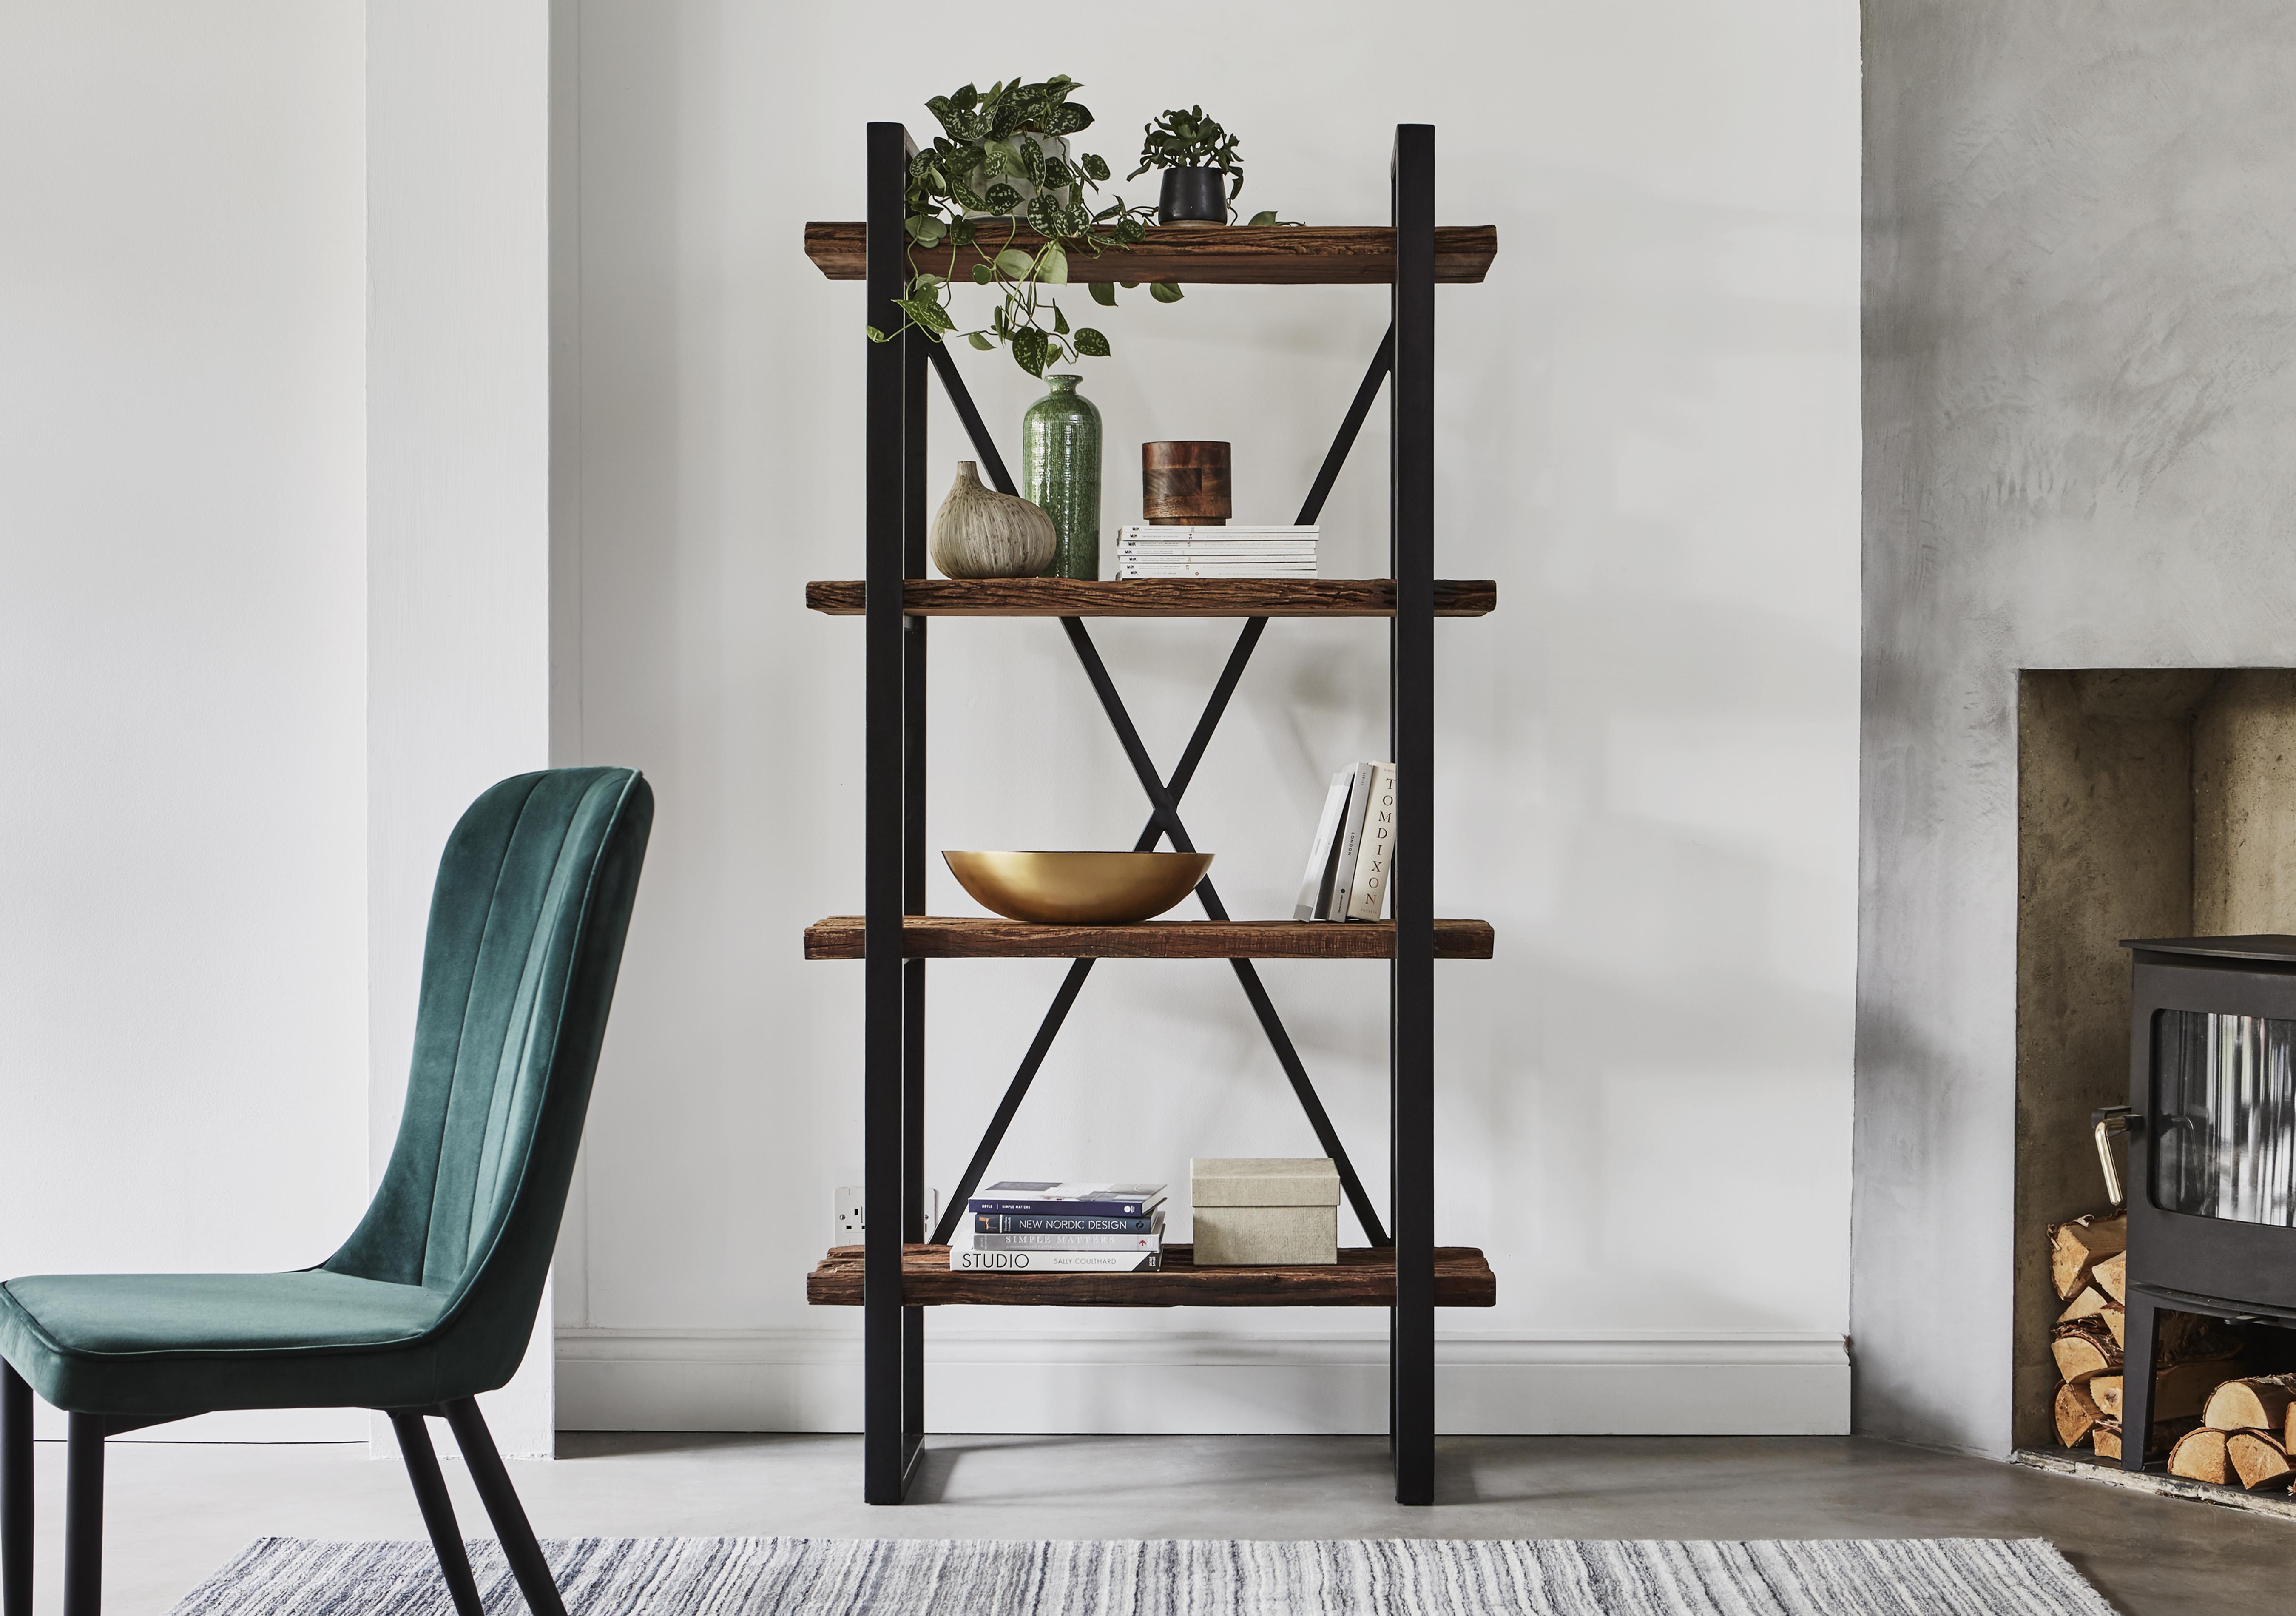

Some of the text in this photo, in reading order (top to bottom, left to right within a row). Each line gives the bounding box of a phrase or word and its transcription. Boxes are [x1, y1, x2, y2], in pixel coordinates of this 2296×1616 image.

[1019, 1220, 1127, 1229] NEW NORDIC DESIGN
[962, 1253, 1029, 1268] STUDIO
